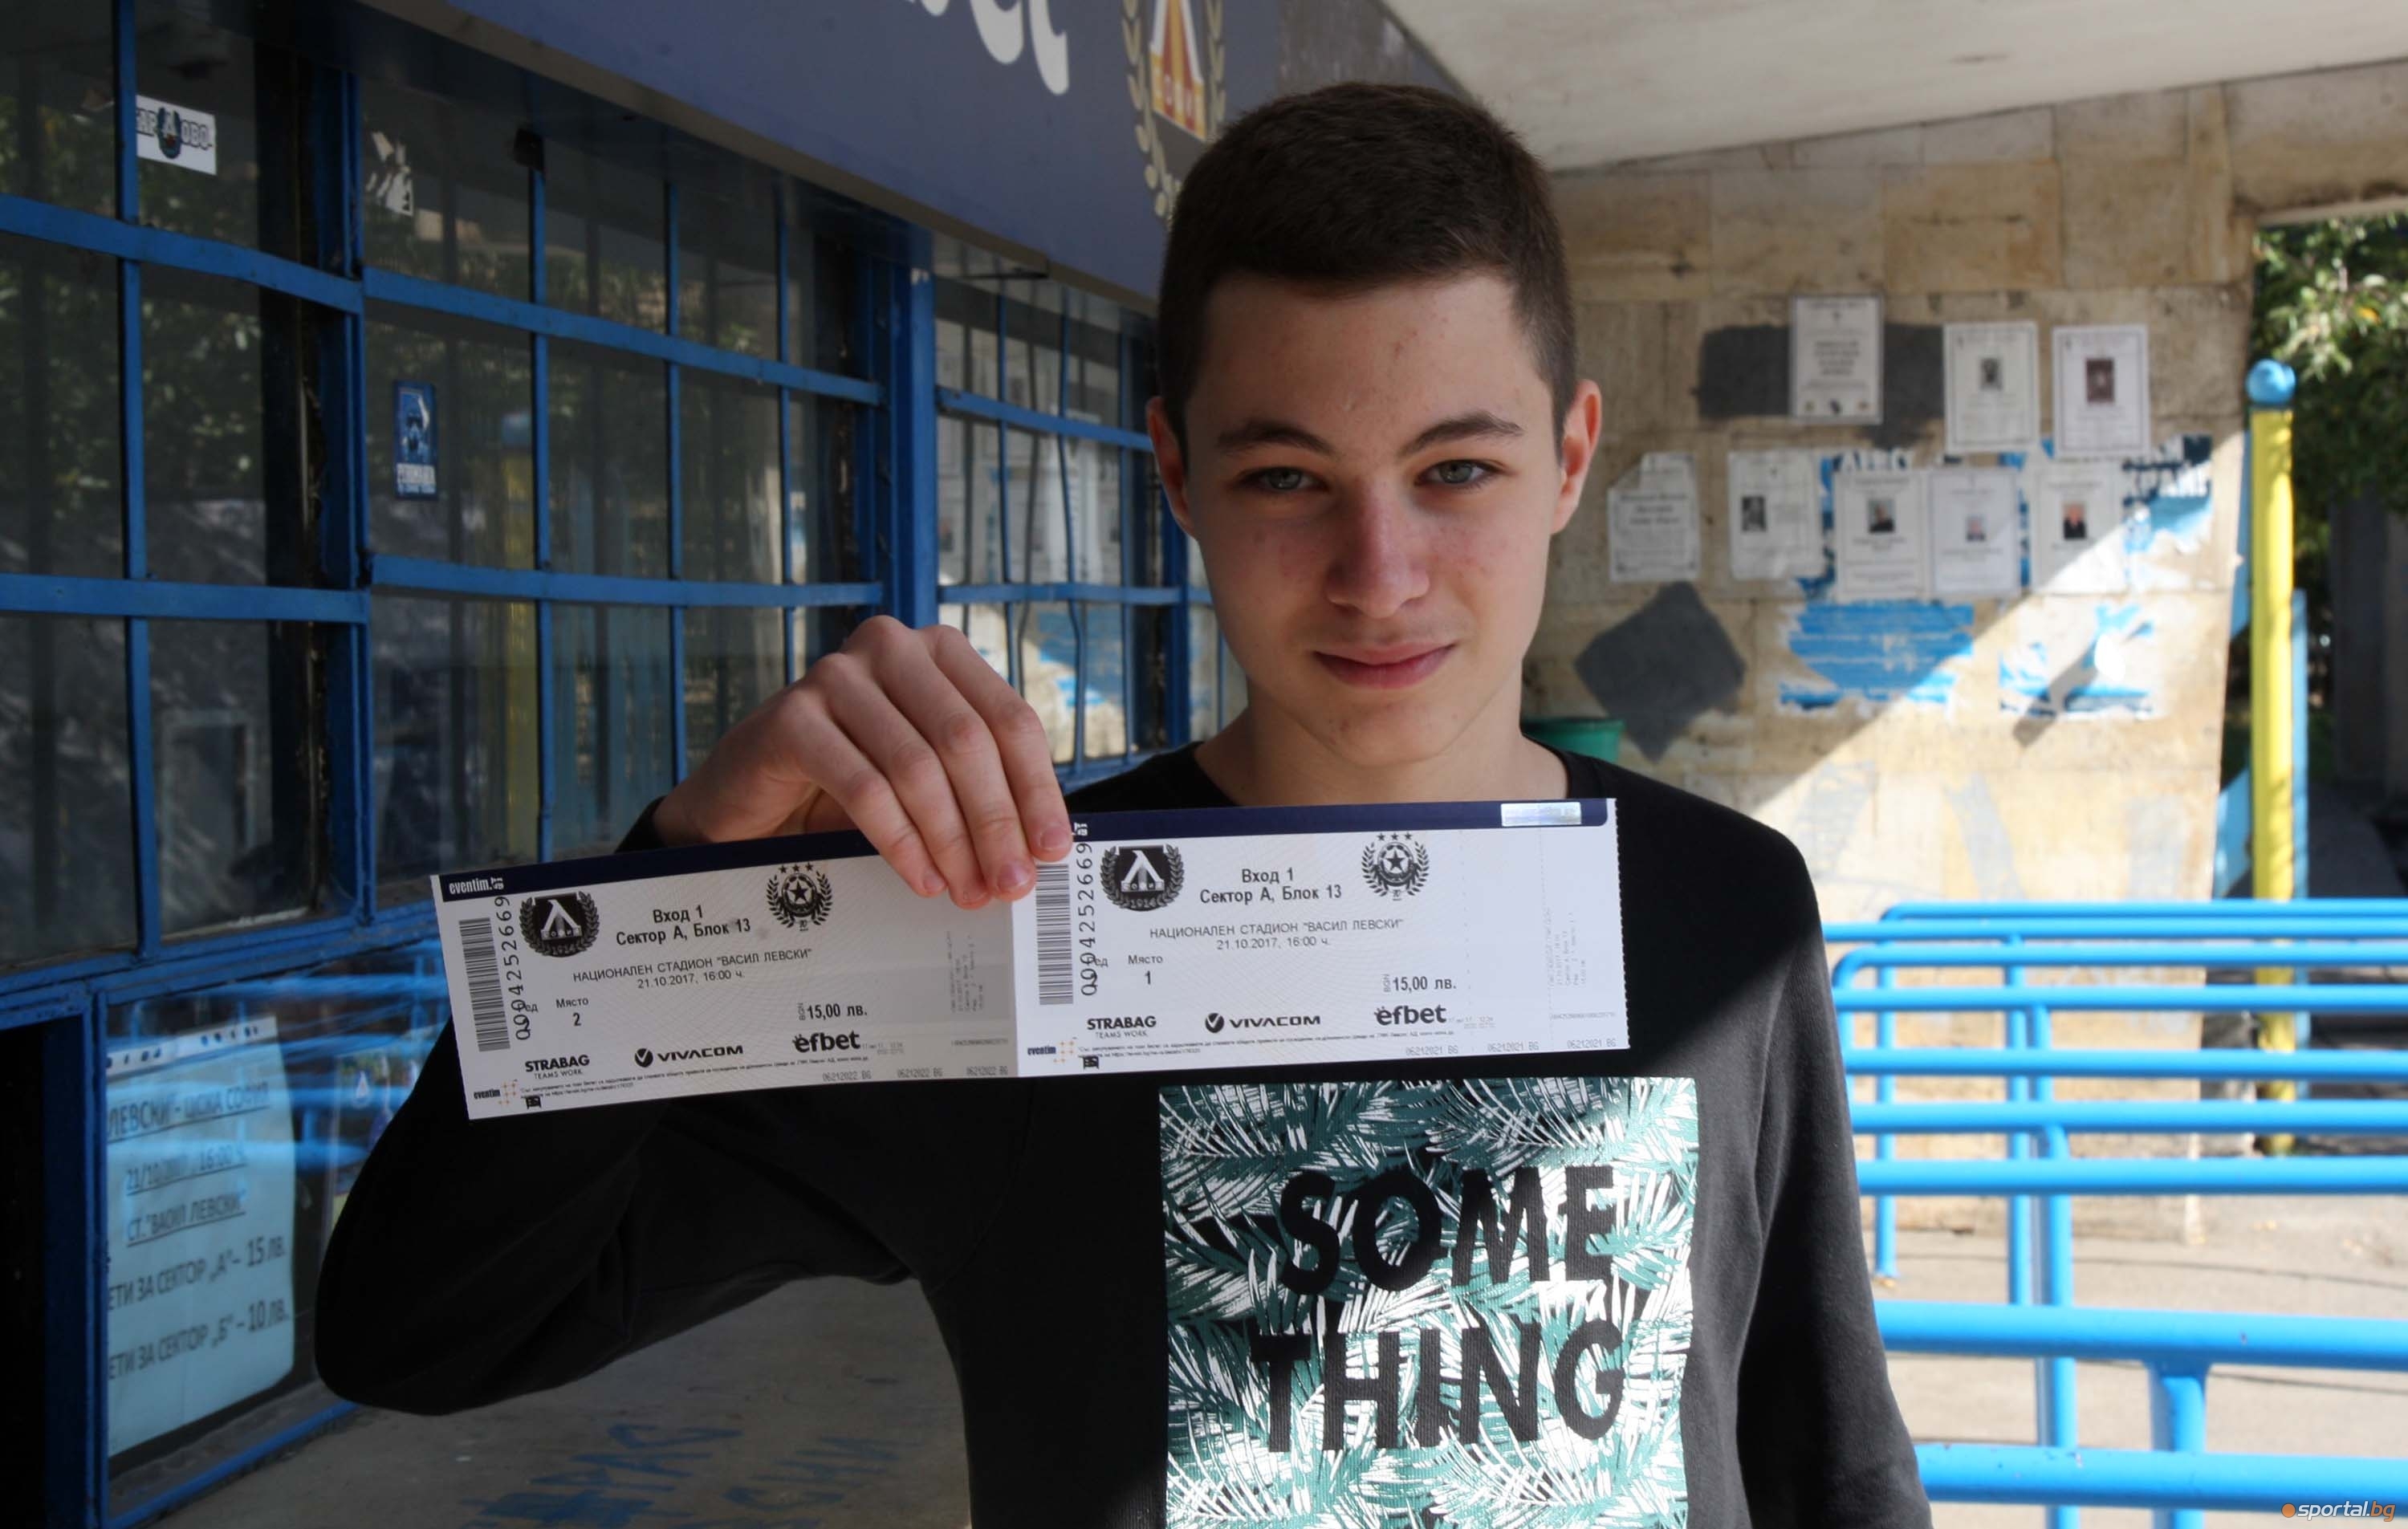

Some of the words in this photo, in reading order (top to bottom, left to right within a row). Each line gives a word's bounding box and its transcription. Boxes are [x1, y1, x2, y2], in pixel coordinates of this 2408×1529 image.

[1242, 868, 1279, 884] Вход
[1287, 868, 1294, 880] 1
[1200, 889, 1252, 905] Сектор
[1259, 889, 1275, 904] А,
[1283, 886, 1320, 901] Блок
[1326, 884, 1341, 899] 13
[653, 908, 690, 924] Вход
[696, 905, 703, 918] 1
[1076, 843, 1097, 996] 0004252669
[616, 929, 666, 945] Сектор
[673, 926, 688, 941] А,
[694, 923, 730, 937] Блок
[736, 918, 751, 933] 13
[1149, 925, 1235, 940] НАЦИОНАЛЕН
[1239, 923, 1298, 936] СТАДИОН
[1303, 921, 1348, 933] "ВАСИЛ
[1352, 918, 1403, 931] ЛЕВСКИ"
[1287, 937, 1317, 947] 16:00
[494, 896, 531, 1040] 0004252669
[573, 964, 653, 983] НАЦИОНАЛЕН
[657, 958, 713, 974] СТАДИОН
[718, 954, 760, 967] "ВАСИЛ
[763, 948, 812, 963] ЛЕВСКИ"
[1128, 954, 1163, 965] Място
[704, 970, 732, 982] 16:00
[1145, 970, 1152, 985] 1
[1392, 976, 1428, 993] 15,00
[1434, 978, 1457, 990] лв.
[555, 998, 589, 1009] Място
[807, 1003, 841, 1020] 15,00
[847, 1005, 868, 1017] лв.
[573, 1013, 581, 1027] 2
[1087, 1015, 1157, 1030] STRABAG
[1230, 1015, 1320, 1028] VIVACOM
[1374, 1005, 1446, 1026] efbet
[792, 1030, 860, 1053] efbet
[657, 1045, 743, 1062] VIVACOM
[1027, 1046, 1056, 1056] eventim
[525, 1054, 590, 1072] STRABAG
[535, 1072, 559, 1080] TEAMS
[561, 1069, 584, 1077] WORK
[474, 1088, 501, 1100] eventim
[1277, 1165, 1614, 1295] SOME
[137, 1275, 155, 1302] ЗА
[157, 1258, 206, 1295] СЕКТОР
[247, 1236, 264, 1267] 15
[138, 1343, 155, 1370] ЗА
[158, 1324, 209, 1362] СЕКТОР
[248, 1300, 266, 1332] 10
[1249, 1320, 1624, 1453] THING
